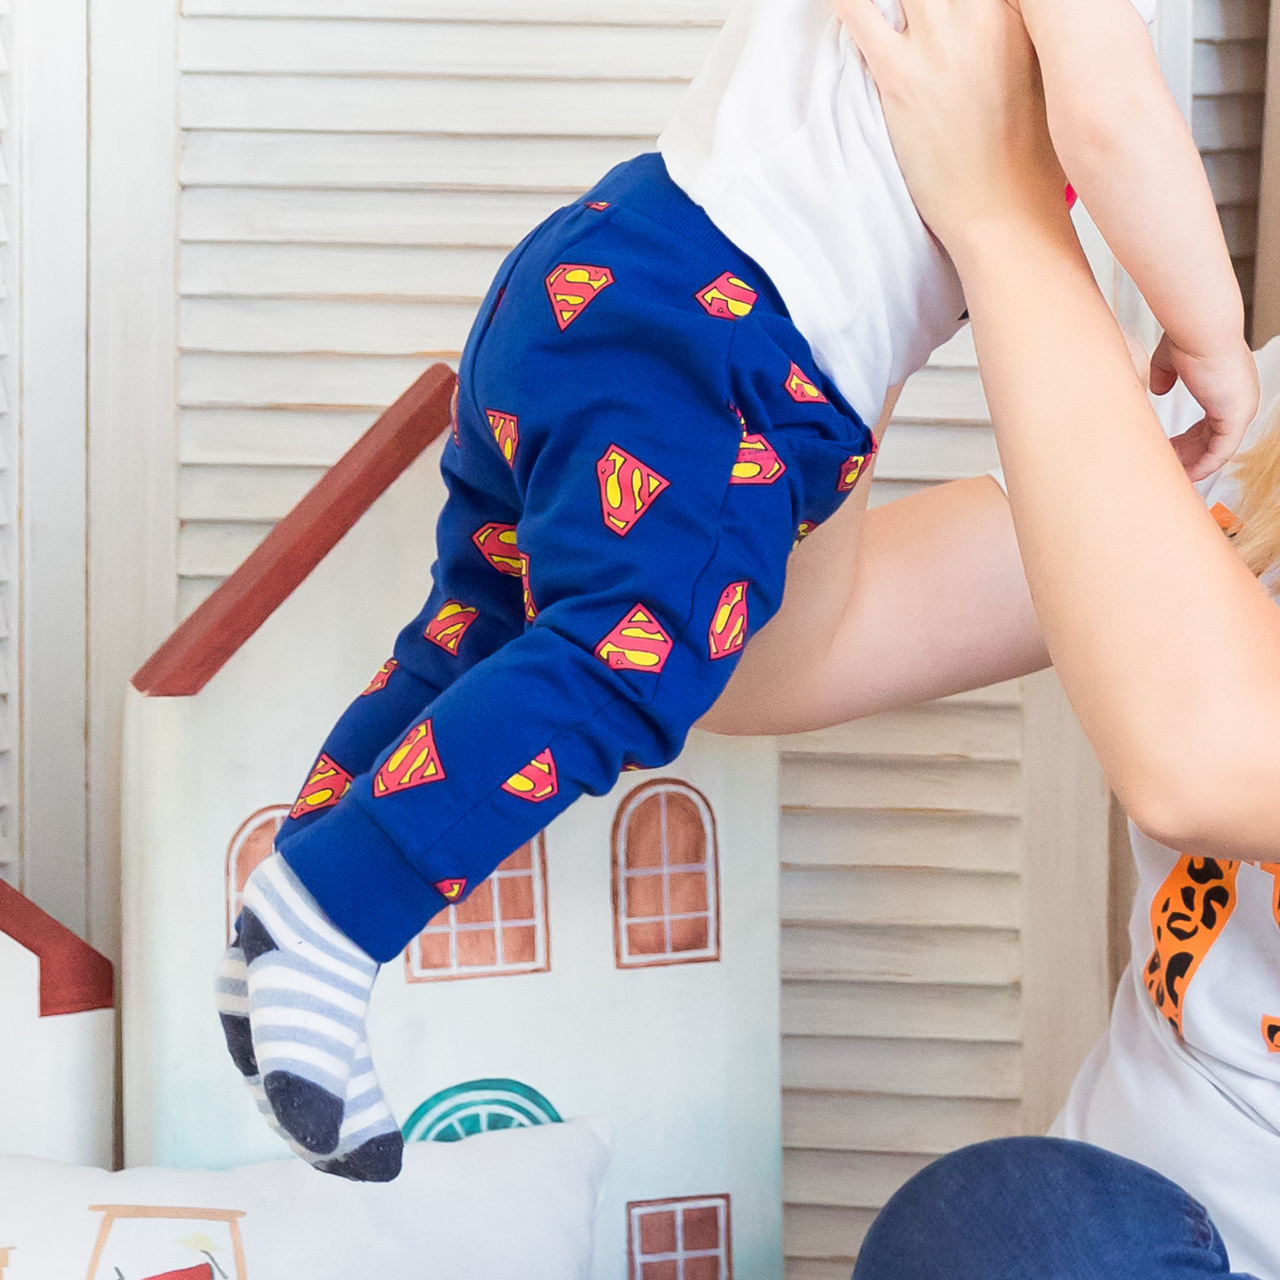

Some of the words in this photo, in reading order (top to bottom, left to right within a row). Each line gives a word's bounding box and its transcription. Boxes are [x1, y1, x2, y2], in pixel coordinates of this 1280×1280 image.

[545, 263, 614, 330] S
[596, 444, 671, 538] S
[594, 603, 673, 672] S
[708, 580, 748, 660] S
[373, 718, 445, 797] S
